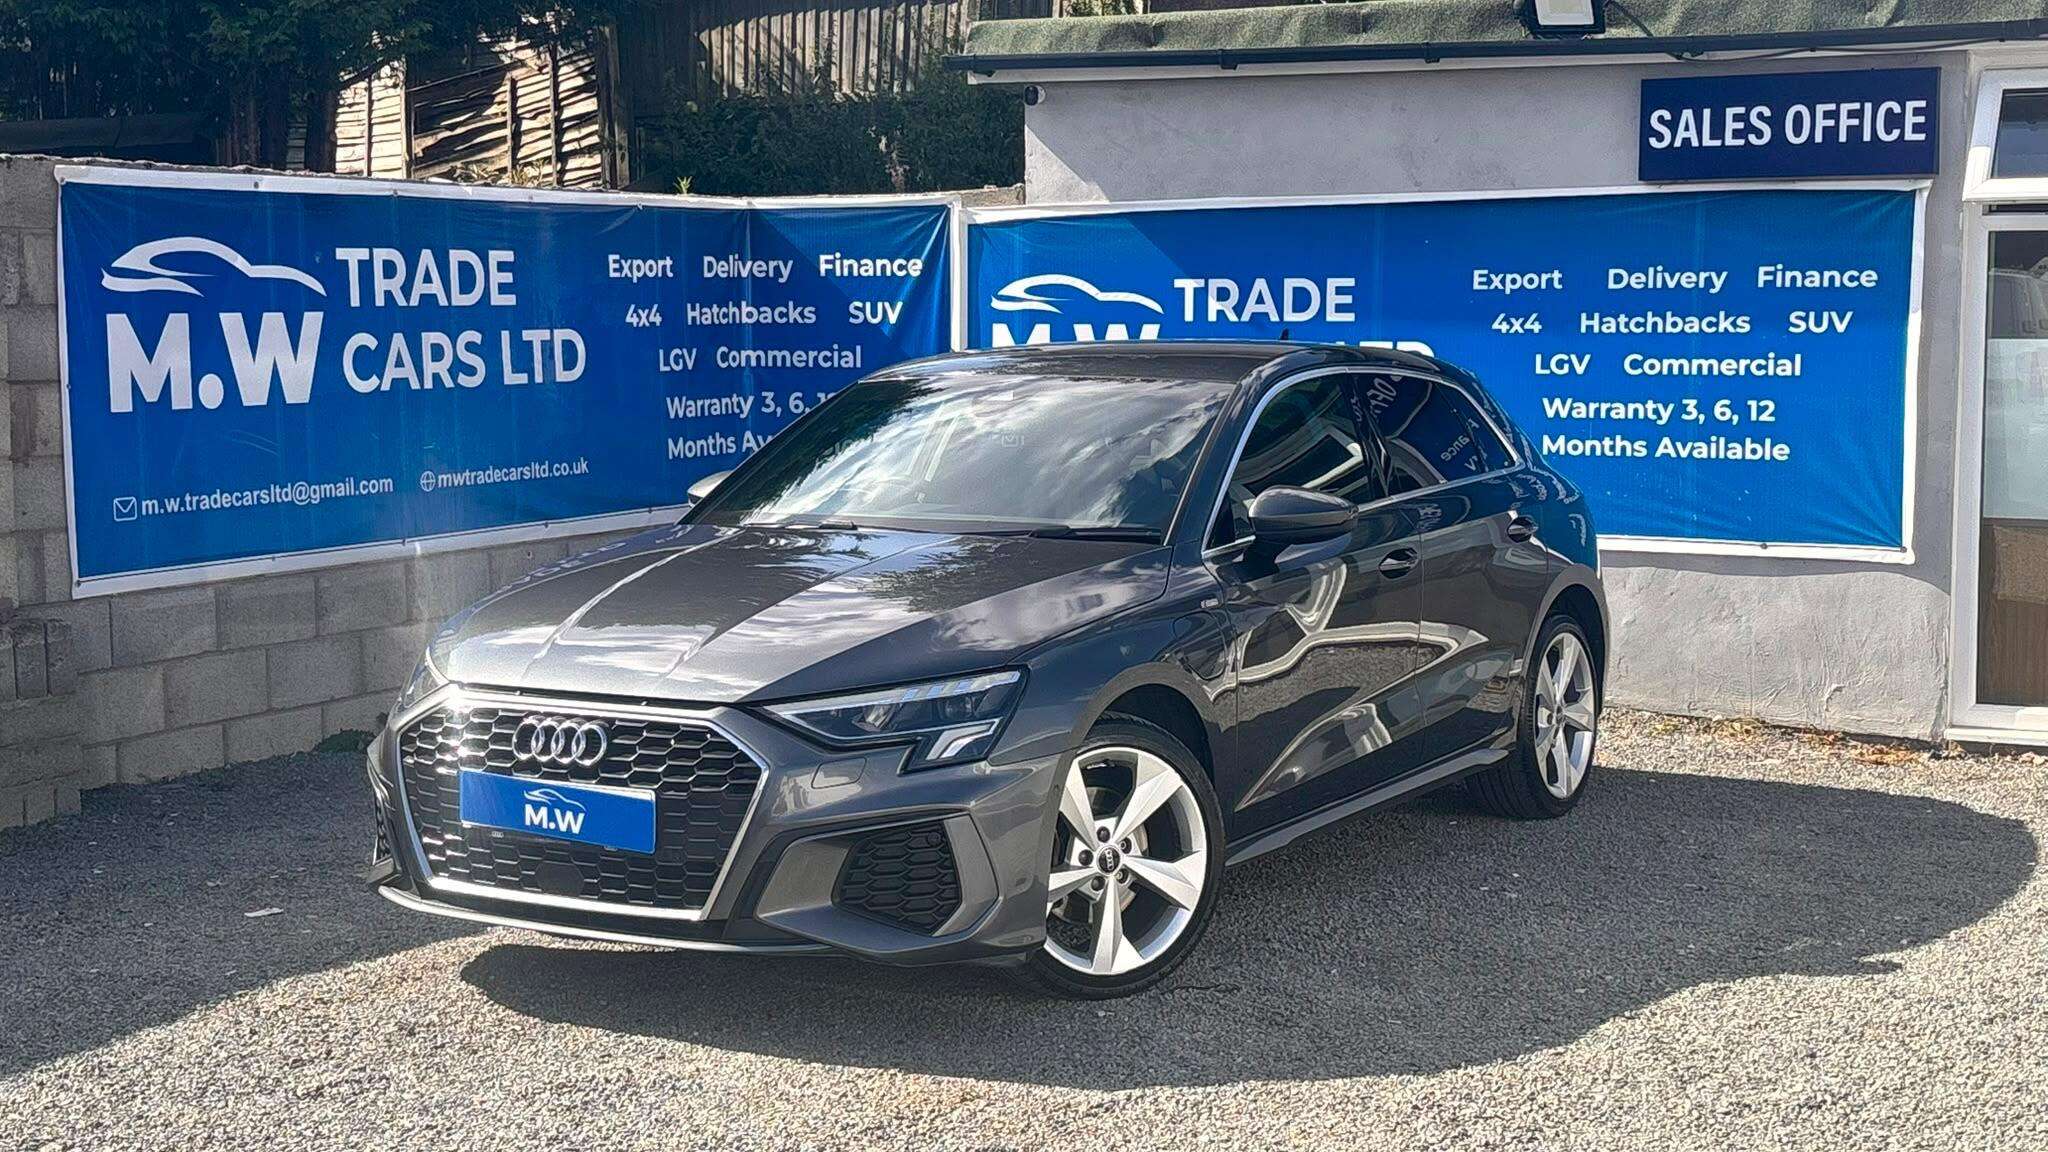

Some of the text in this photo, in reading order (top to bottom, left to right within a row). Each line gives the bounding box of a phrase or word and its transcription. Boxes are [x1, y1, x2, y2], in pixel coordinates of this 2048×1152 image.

[1649, 100, 1927, 149] SALES OFFICE
[336, 247, 517, 308] TRADE
[608, 252, 924, 283] Export Delivery Finance
[1472, 264, 1878, 294] Export Delivery Finance
[625, 301, 904, 327] 4x4 Hatchbacks SUV
[1173, 277, 1356, 322] TRADE
[1491, 310, 1854, 334] 4x4 Hatchbacks SUV
[106, 311, 325, 413] M.W
[342, 328, 587, 393] CARS LTD
[658, 344, 862, 372] LGV Commercial
[1535, 352, 1802, 377] LGV Commercial
[666, 393, 755, 419] Warranty
[761, 391, 782, 418] 3,
[1542, 397, 1776, 426] Warranty 3, 6, 12
[667, 431, 737, 460] Months
[1542, 434, 1791, 461] Months Available
[437, 456, 589, 490] mwtradecarsltd.co.uk
[141, 476, 394, 516] m.w.tradecarsltd@gmail.com
[524, 803, 586, 835] M.W
